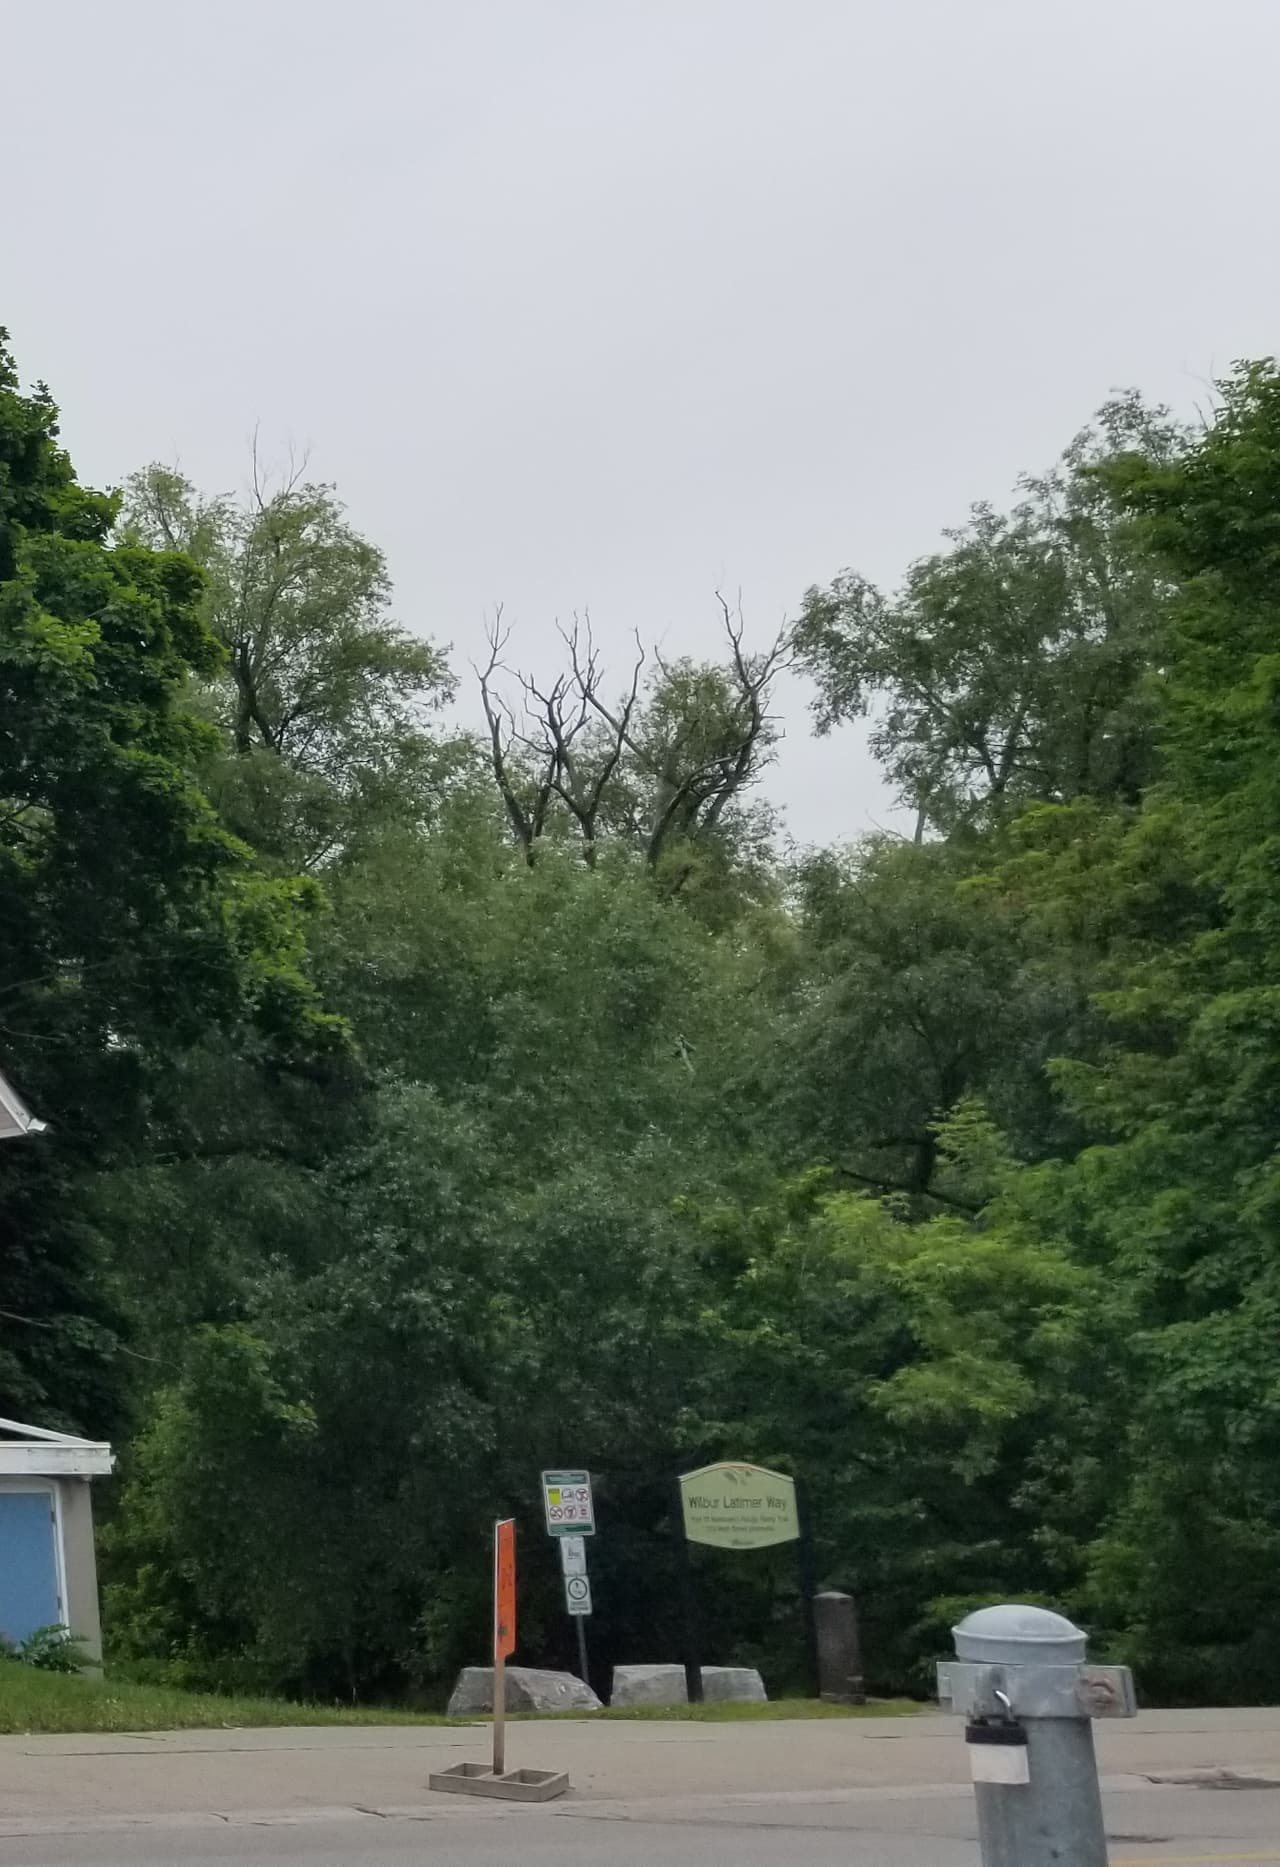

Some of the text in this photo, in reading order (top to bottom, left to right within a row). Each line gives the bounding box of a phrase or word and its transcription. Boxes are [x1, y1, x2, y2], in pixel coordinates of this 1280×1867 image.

[688, 1496, 787, 1511] Wilbur Latimer Way
